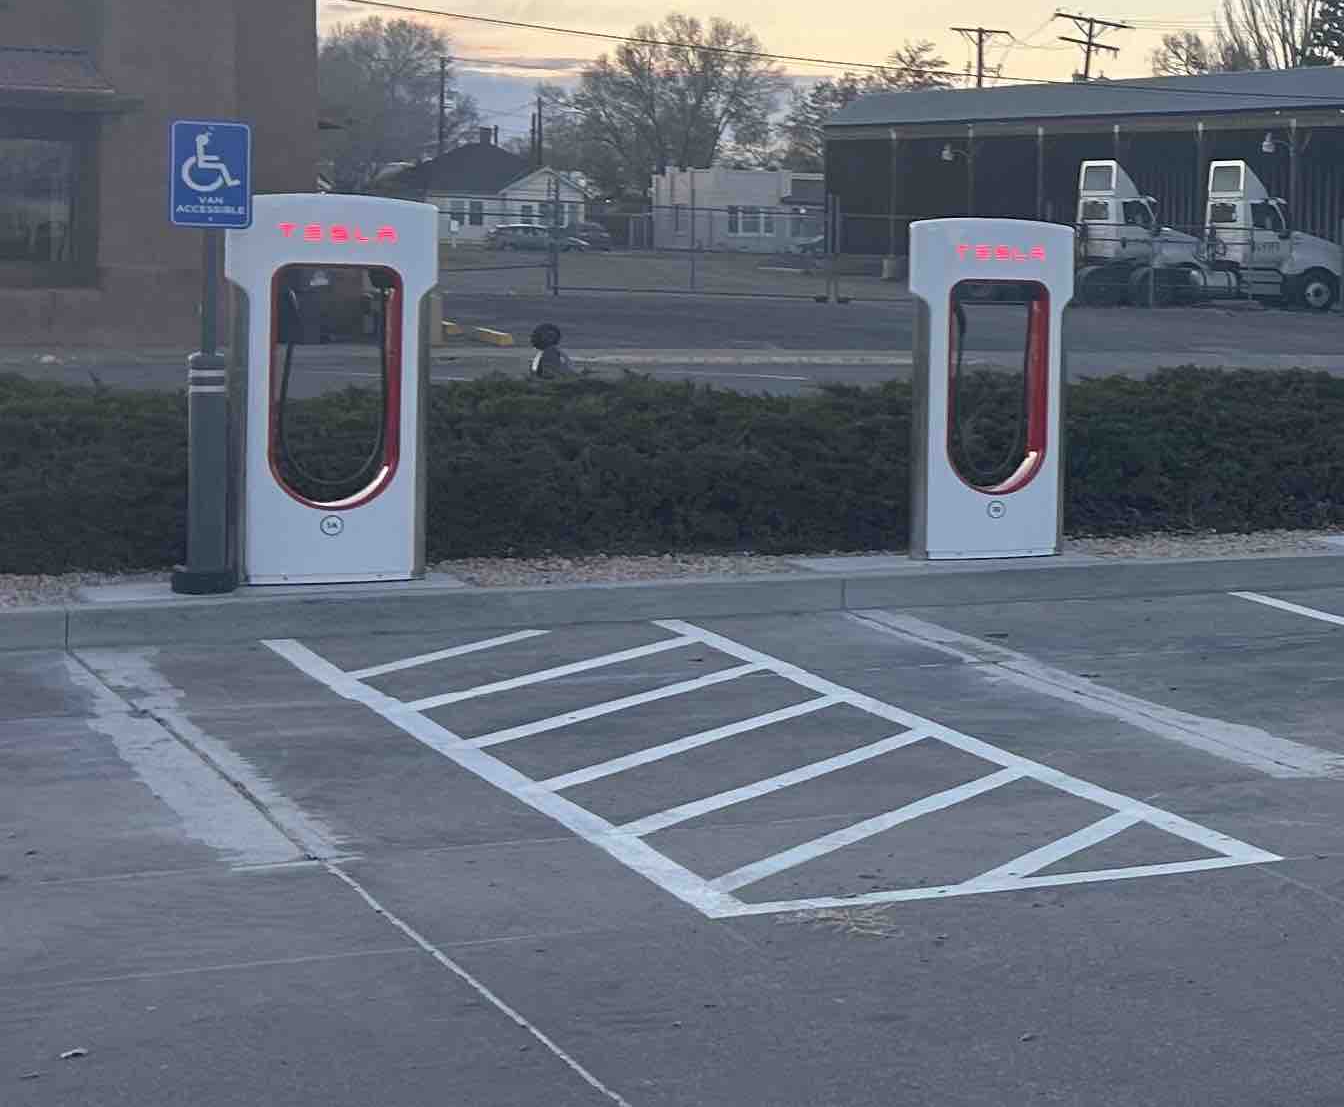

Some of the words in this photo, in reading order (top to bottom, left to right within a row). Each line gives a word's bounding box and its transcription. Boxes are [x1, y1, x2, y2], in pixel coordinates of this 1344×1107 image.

[199, 196, 224, 204] VAN
[176, 205, 246, 214] ACCESSIBLE
[276, 222, 399, 244] TESLA
[956, 244, 1045, 262] TESLA
